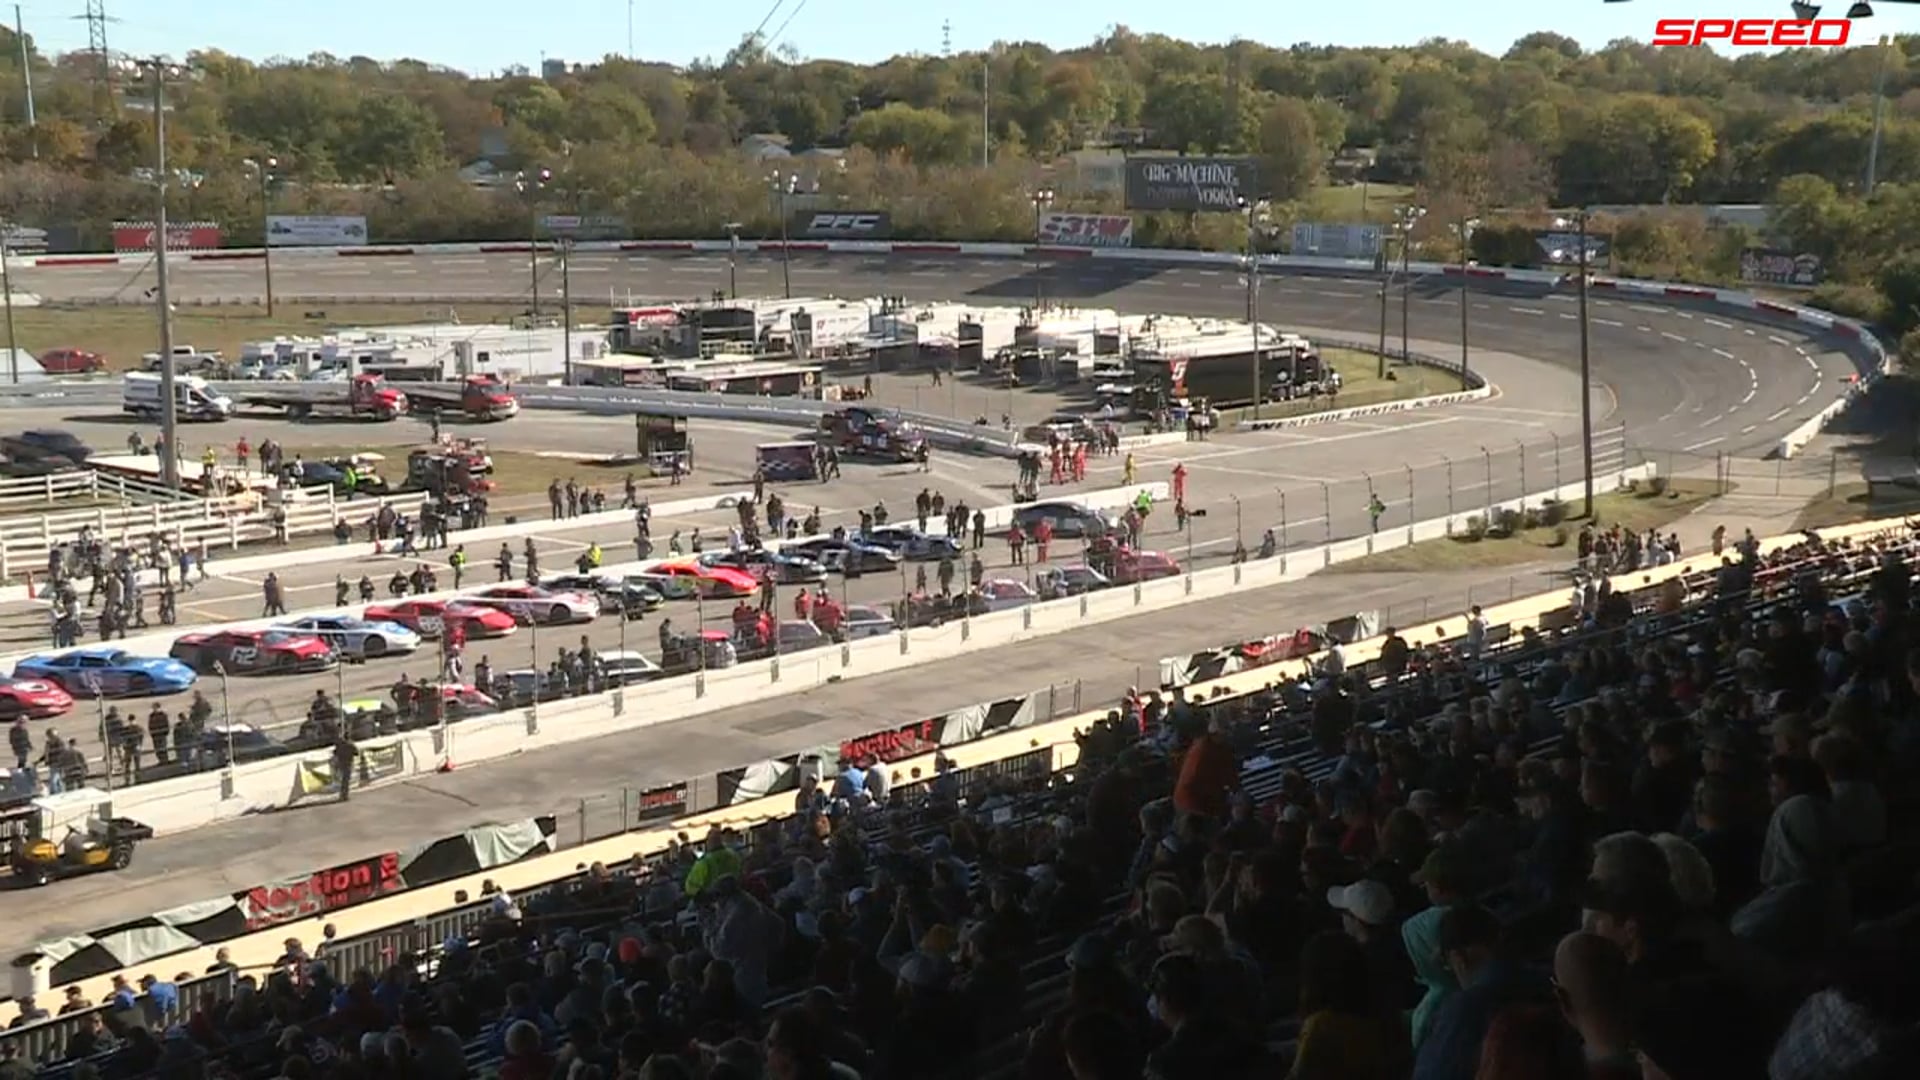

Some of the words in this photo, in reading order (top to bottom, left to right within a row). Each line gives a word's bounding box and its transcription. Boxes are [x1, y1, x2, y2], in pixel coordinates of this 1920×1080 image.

[1143, 164, 1171, 183] BIG
[1172, 161, 1237, 184] MACHINE
[809, 214, 880, 230] PFC
[1349, 403, 1406, 418] RENTAL
[1428, 393, 1475, 407] SALES
[921, 719, 935, 739] F
[381, 851, 400, 879] E
